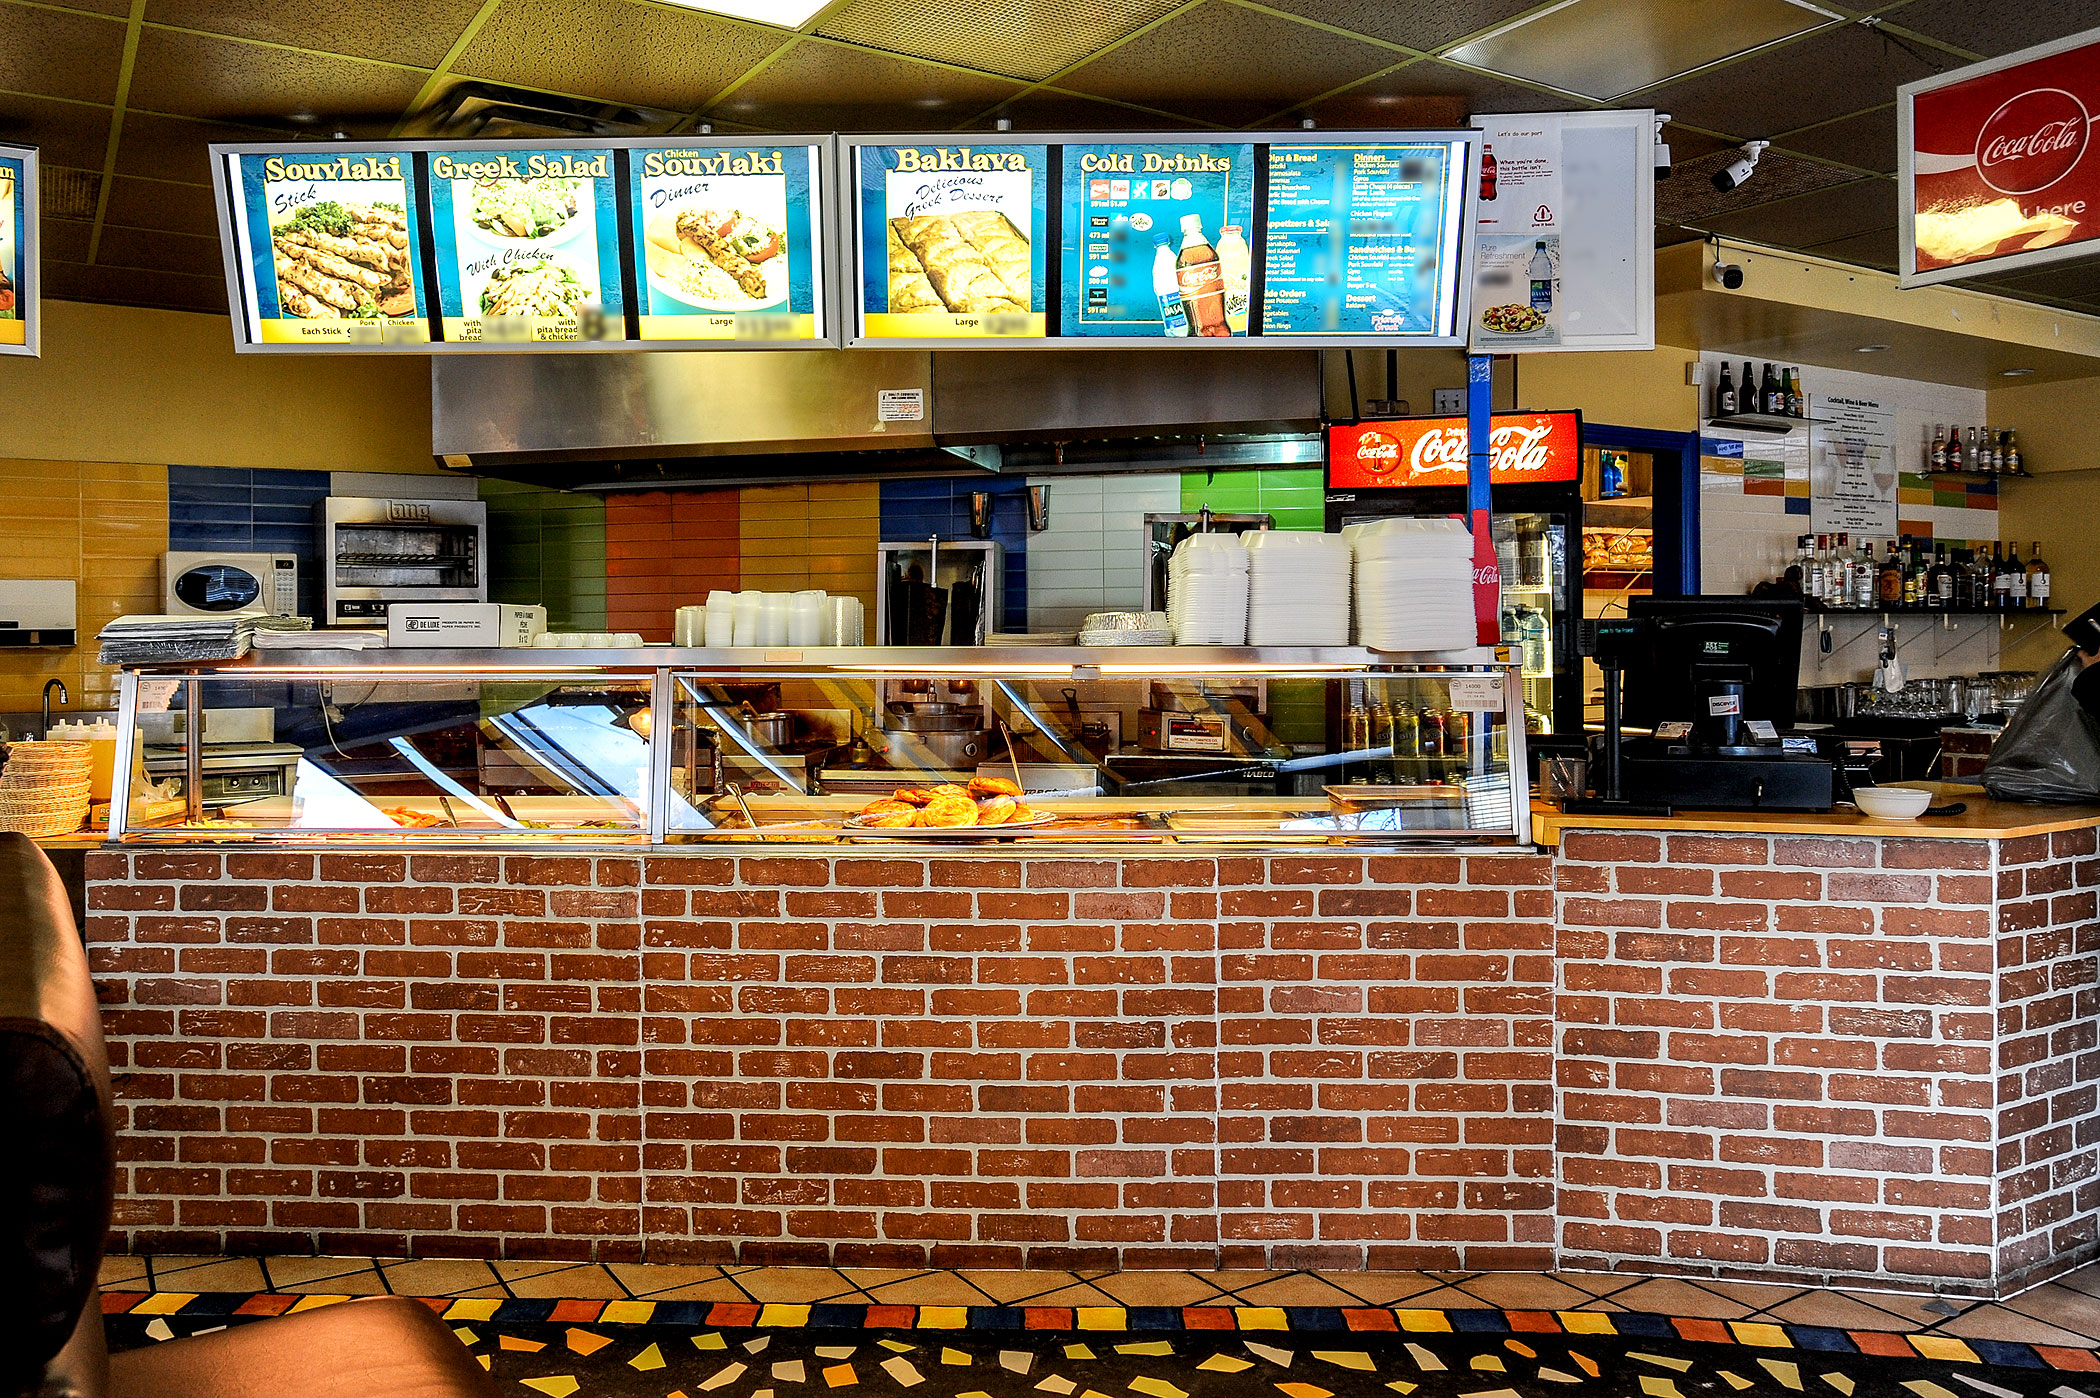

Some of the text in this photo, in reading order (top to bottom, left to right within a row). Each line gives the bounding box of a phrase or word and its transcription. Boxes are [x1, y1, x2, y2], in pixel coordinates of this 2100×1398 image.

[1982, 117, 2082, 167] Coca-Cola
[664, 149, 699, 157] Chicken
[1285, 153, 1293, 162] &
[1293, 153, 1318, 162] Bread
[1354, 153, 1386, 162] Dinners
[644, 151, 784, 178] Souvlaki
[893, 148, 1026, 172] Baklava
[1080, 153, 1231, 172] Cold Drinks
[264, 156, 402, 183] Souvlaki
[432, 154, 609, 180] Greek Salad
[916, 176, 983, 200] Delicious
[274, 184, 316, 214] Stick
[650, 183, 709, 208] Dinner
[1348, 245, 1396, 254] Sandwiches
[1481, 243, 1497, 252] Pure
[503, 248, 554, 265] Chicken
[1480, 252, 1526, 260] Refreshment
[1279, 289, 1306, 298] Orders
[1346, 294, 1376, 302] Dessert
[1163, 303, 1183, 317] DASA
[710, 317, 733, 325] Large
[955, 318, 979, 326] Large
[466, 328, 481, 336] pita
[1356, 444, 1398, 460] Coca-Cola
[428, 620, 440, 628] LUXE
